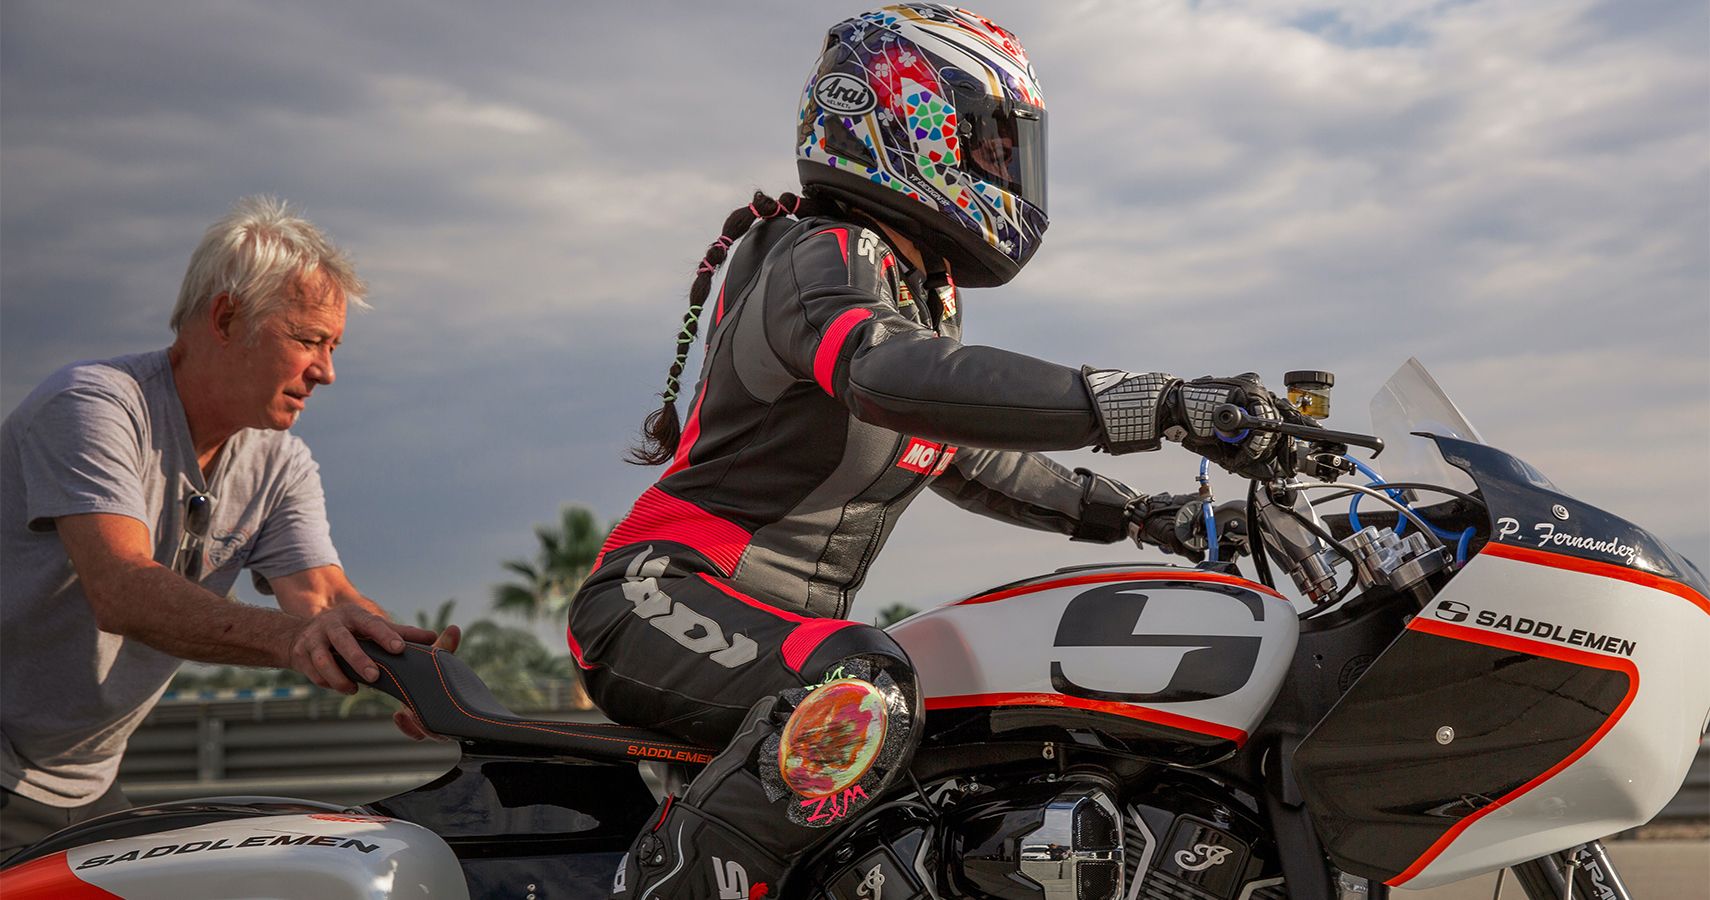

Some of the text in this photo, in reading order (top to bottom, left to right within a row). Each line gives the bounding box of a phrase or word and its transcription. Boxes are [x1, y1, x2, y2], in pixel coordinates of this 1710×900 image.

[818, 78, 867, 105] Arai
[1497, 517, 1637, 565] P. Fernandez
[1476, 610, 1637, 656] SADDLEMEN
[76, 835, 381, 870] SADDLEMEN
